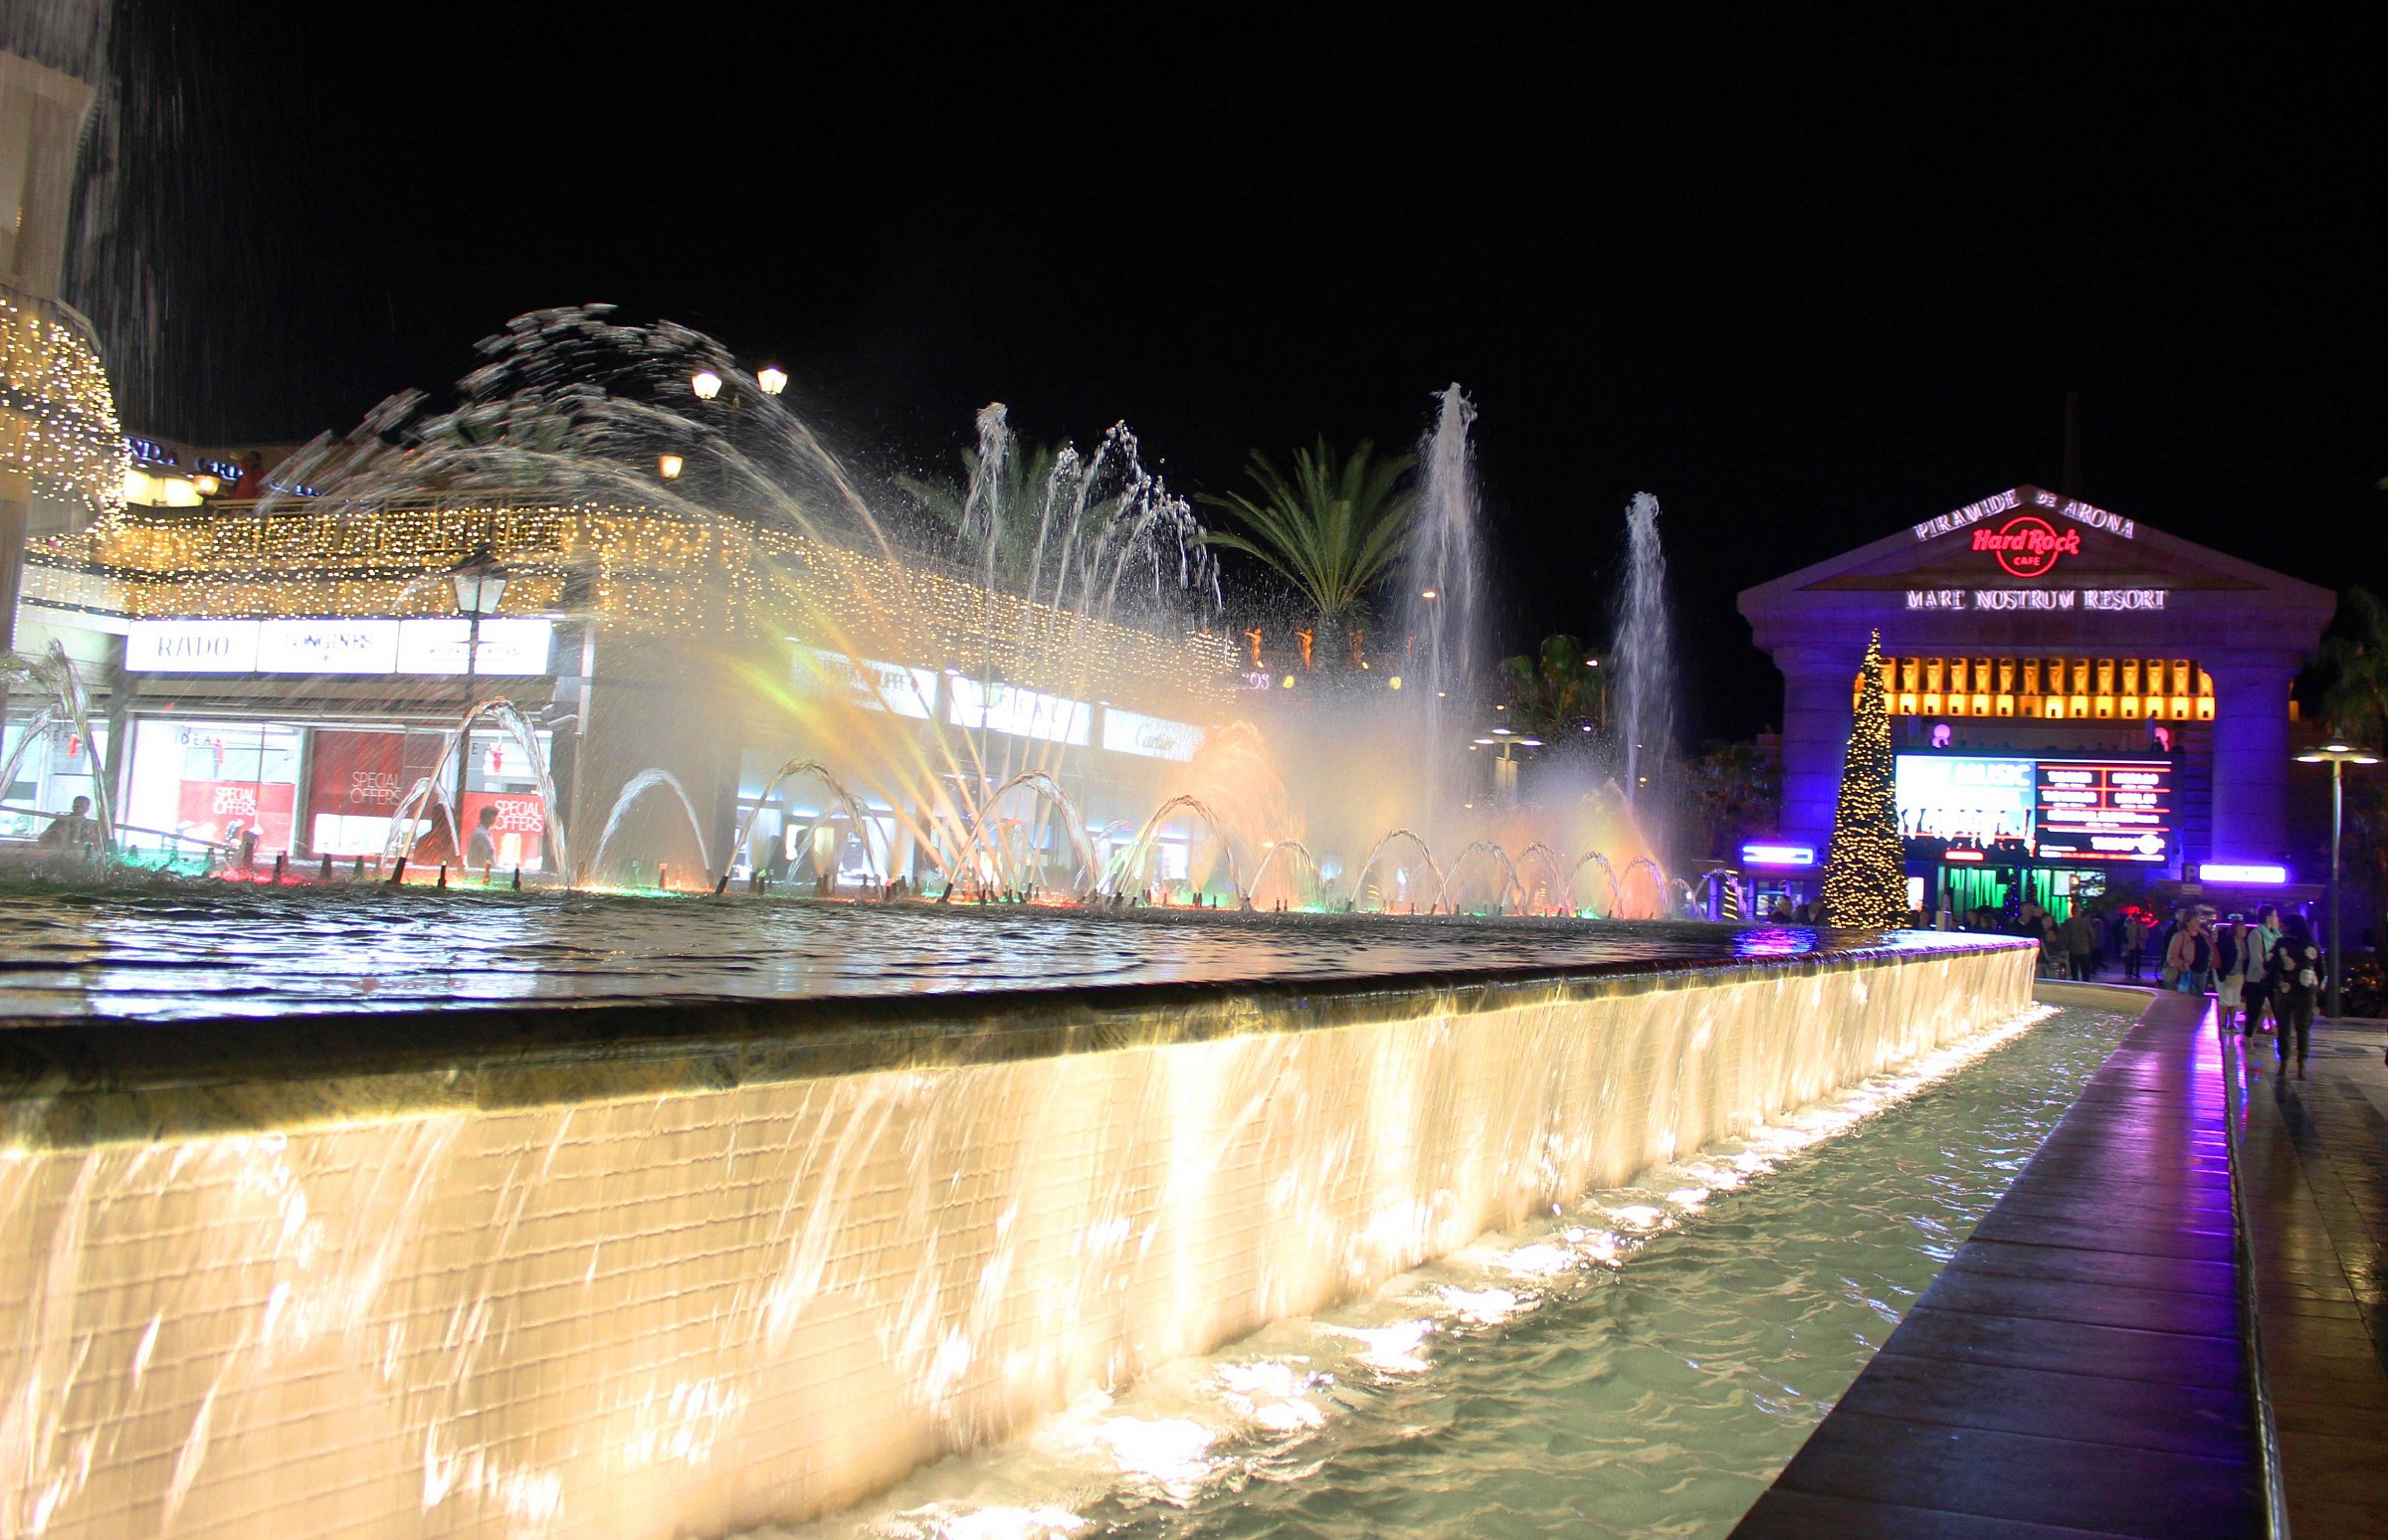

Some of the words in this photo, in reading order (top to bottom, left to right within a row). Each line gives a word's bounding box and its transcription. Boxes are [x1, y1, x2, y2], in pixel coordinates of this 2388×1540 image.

[1914, 487, 2021, 542] PIRAMIDE
[2037, 490, 2058, 508] DE
[2064, 498, 2134, 539] ARONA
[1971, 528, 2028, 552] Hard
[2029, 528, 2082, 556] Rock
[2012, 555, 2041, 567] CAFE
[1905, 589, 1966, 610] MARE
[1973, 589, 2076, 611] NOSTRUM
[2084, 589, 2168, 611] RESORT
[157, 636, 230, 657] RADO
[351, 771, 402, 790] SPECIAL
[214, 786, 257, 804] SPECIAL
[350, 787, 402, 806] OFFERS
[212, 800, 256, 816] OFFERS
[495, 799, 543, 819] SPECIAL
[495, 815, 542, 833] OFFERS
